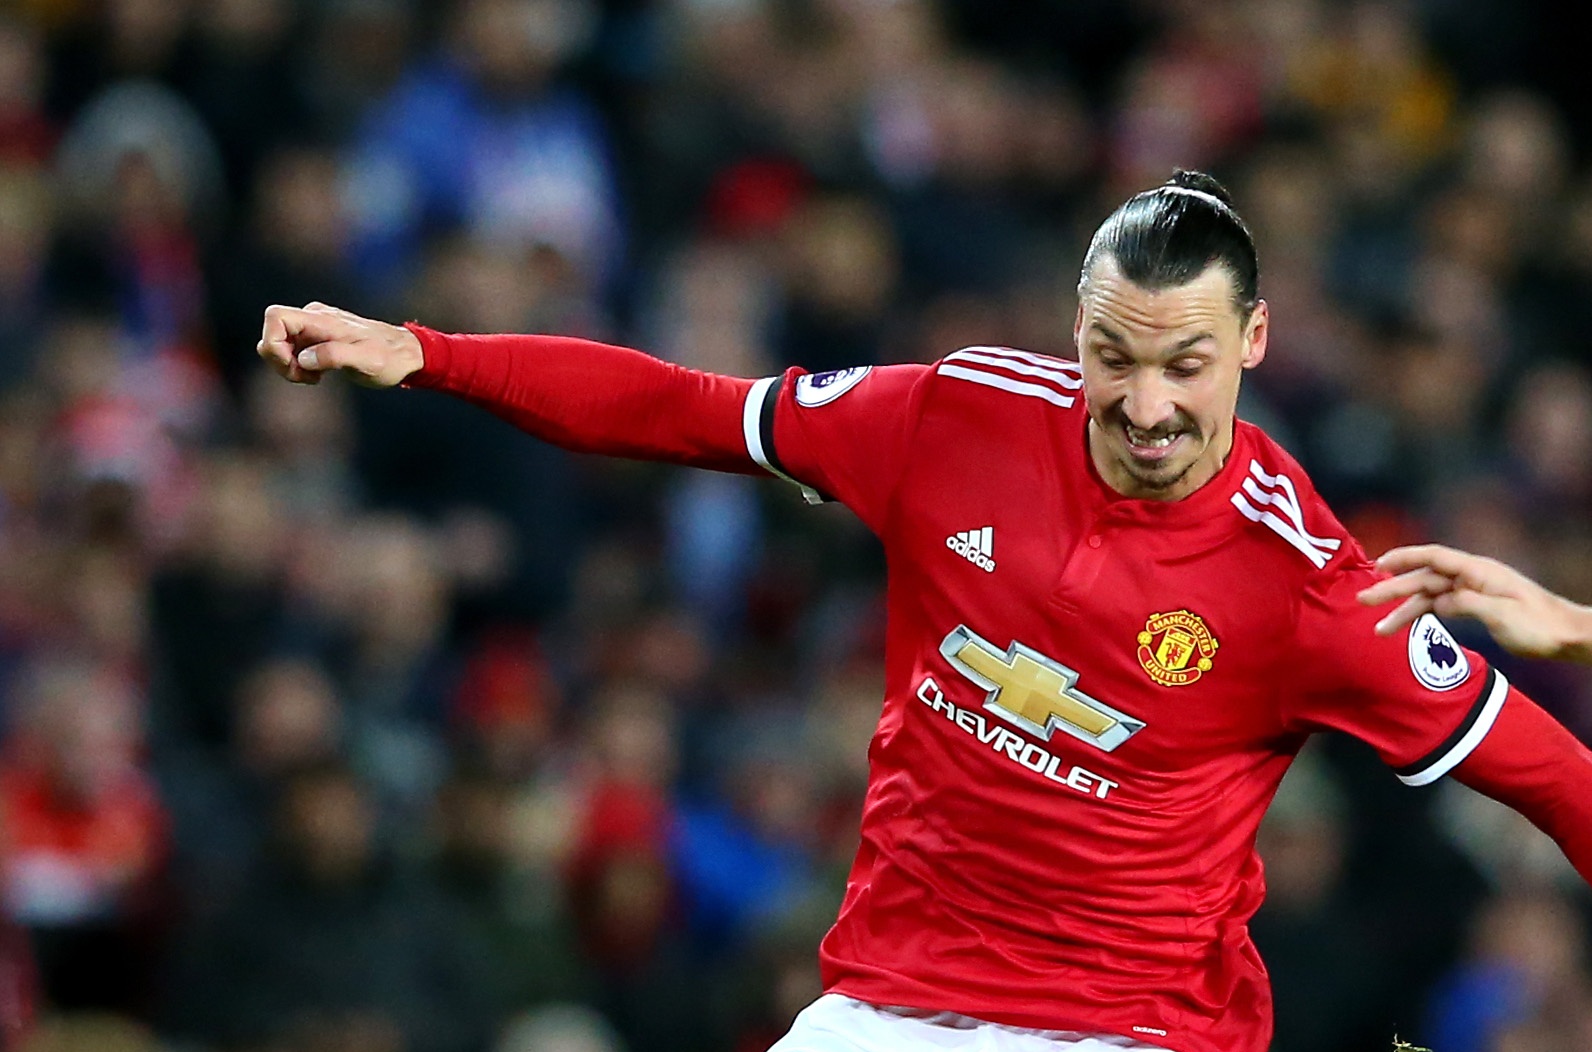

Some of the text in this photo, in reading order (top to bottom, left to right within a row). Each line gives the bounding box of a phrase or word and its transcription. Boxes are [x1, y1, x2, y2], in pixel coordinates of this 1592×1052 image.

[945, 535, 997, 573] adidas
[1152, 615, 1212, 653] MANCHESTER
[1145, 659, 1188, 683] UNITED
[916, 676, 1119, 799] CHEVROLET
